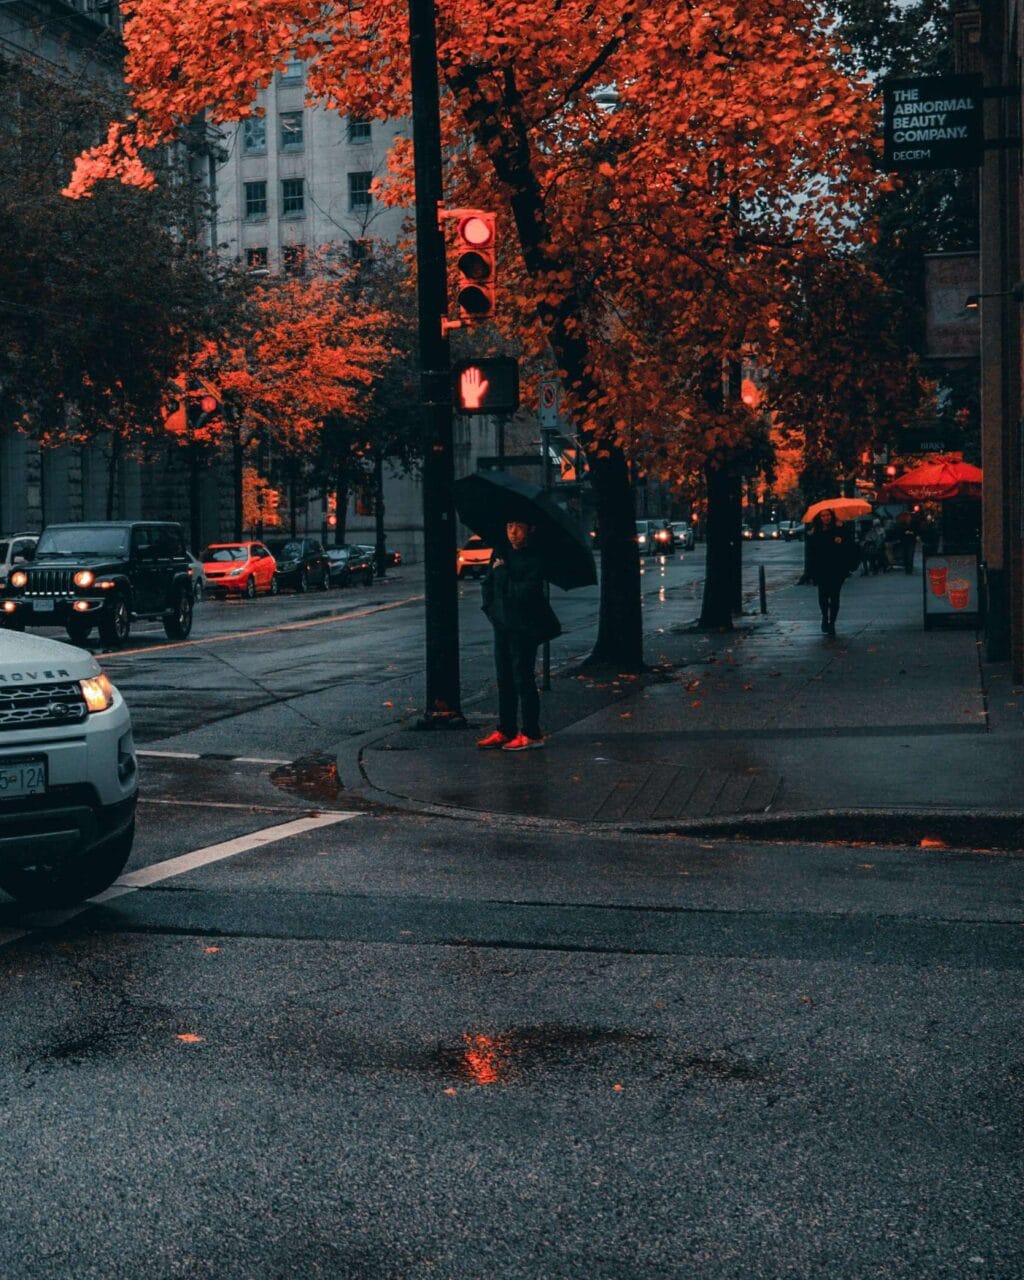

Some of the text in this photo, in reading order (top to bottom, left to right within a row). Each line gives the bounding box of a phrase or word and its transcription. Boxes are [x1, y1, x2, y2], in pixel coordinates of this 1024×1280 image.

[893, 89, 919, 102] THE
[893, 98, 974, 116] ABNORMAL
[893, 114, 947, 129] BEAUTY
[893, 126, 968, 143] COMPANY.
[893, 149, 931, 161] DECIEM
